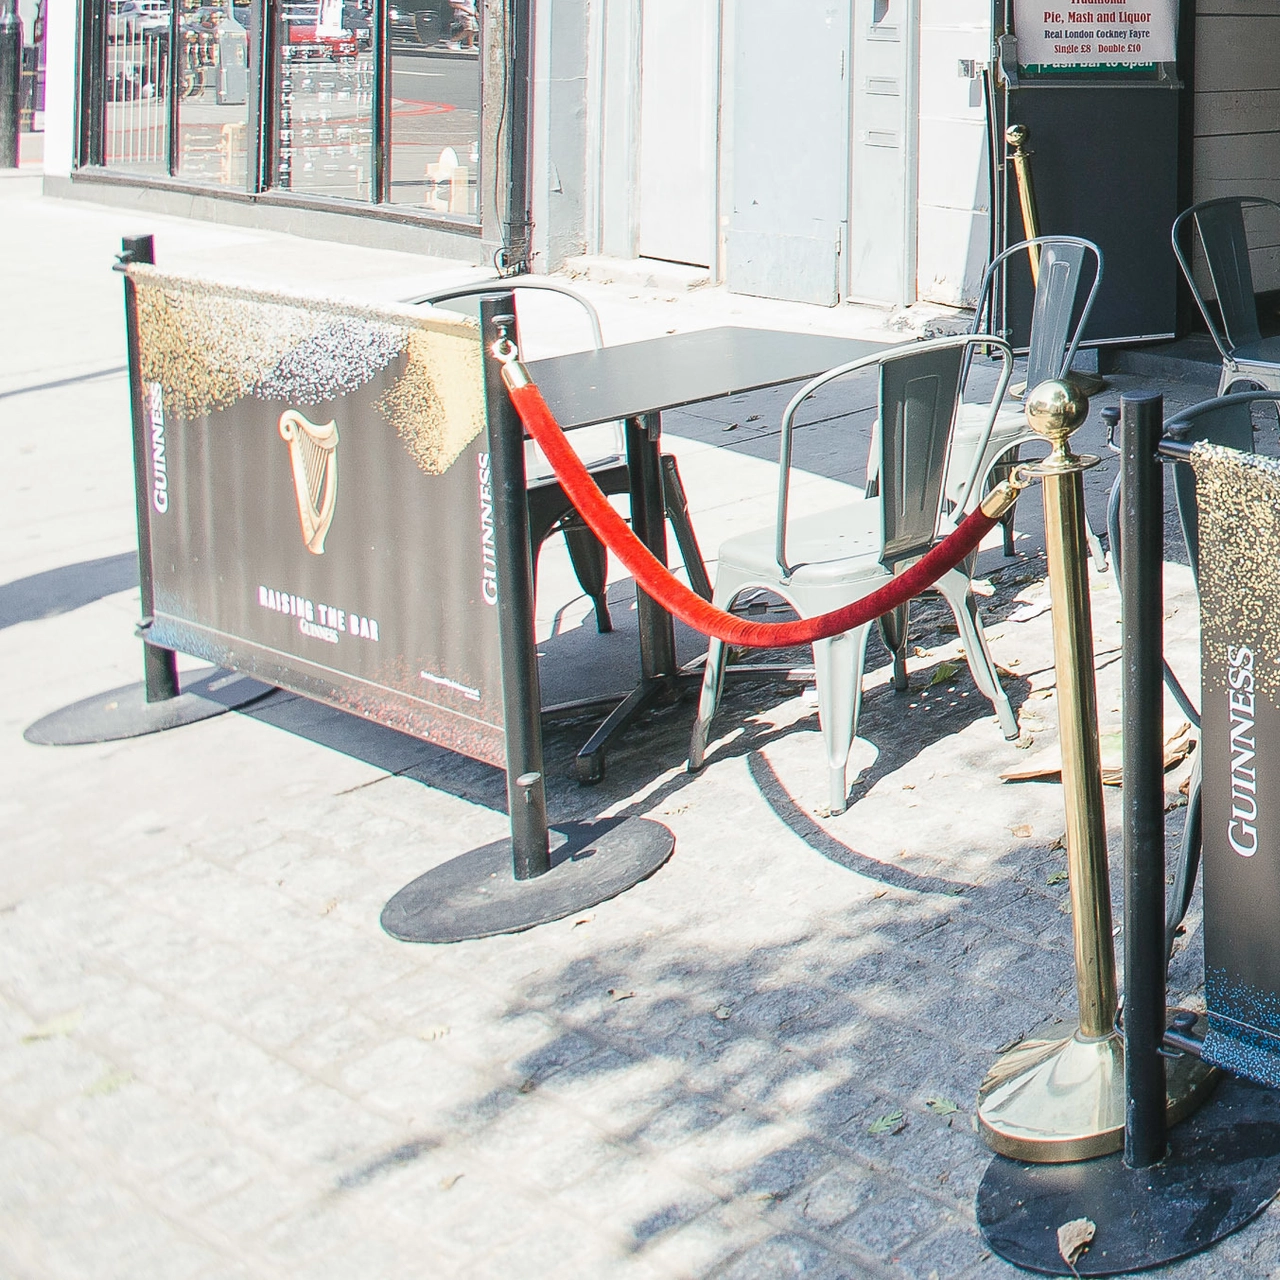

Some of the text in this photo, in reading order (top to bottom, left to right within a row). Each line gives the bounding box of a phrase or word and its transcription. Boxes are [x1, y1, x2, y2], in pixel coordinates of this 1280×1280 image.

[1044, 11, 1151, 25] Pie, Mash and Liquor
[1044, 29, 1150, 39] Real London Cockney Fayre
[1054, 43, 1141, 54] Single £8 Double £10
[150, 380, 169, 514] GUINNESS
[478, 452, 499, 606] GUINNESS
[257, 585, 380, 642] RAISING THE BAR
[1227, 644, 1259, 857] GUINNESS
